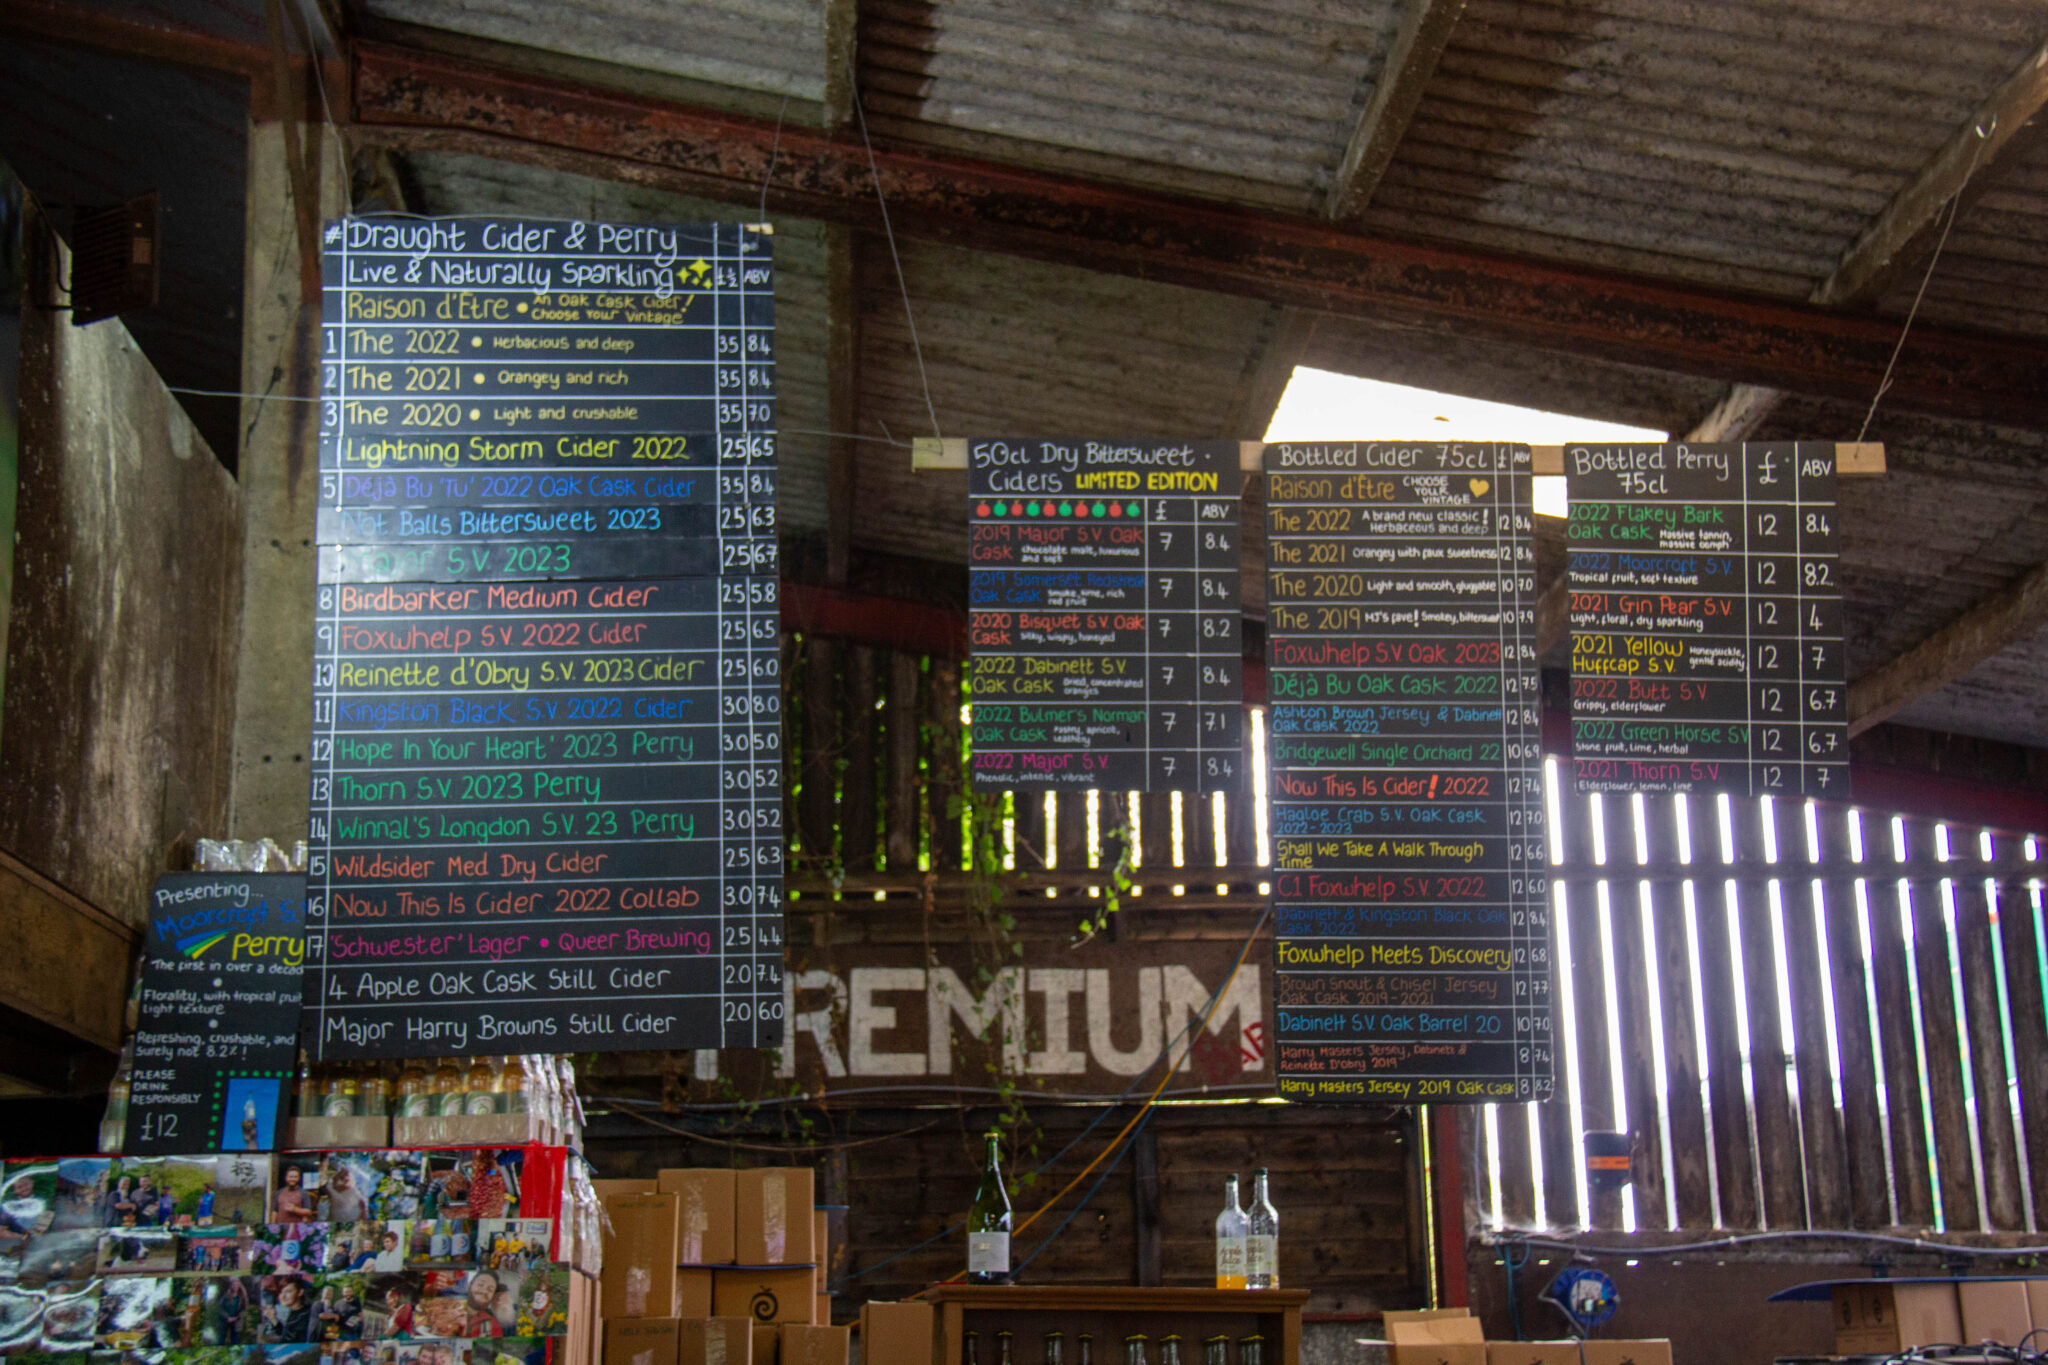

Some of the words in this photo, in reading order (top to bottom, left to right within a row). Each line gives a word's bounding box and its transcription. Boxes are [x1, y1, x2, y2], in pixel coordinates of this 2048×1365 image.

[349, 222, 465, 259] Draught
[482, 221, 559, 251] Cider
[564, 221, 584, 251] &
[599, 225, 677, 266] Perry
[349, 260, 397, 284] Live
[404, 261, 422, 283] &
[431, 259, 550, 295] Naturally
[562, 261, 674, 299] Sparkling
[326, 331, 336, 353] 1
[347, 329, 393, 354] The
[406, 330, 460, 354] 2022
[576, 337, 598, 349] and
[602, 337, 634, 352] deep
[324, 404, 338, 426] 3
[346, 402, 388, 425] The
[402, 404, 461, 426] 2020
[494, 406, 532, 424] Light
[539, 407, 565, 420] and
[572, 406, 638, 420] crushable
[346, 438, 459, 468] Lightning
[468, 438, 542, 460] Storm
[557, 437, 619, 459] Cider
[632, 437, 690, 460] 2022
[974, 442, 1030, 467] 50cl
[1040, 444, 1078, 472] Dry
[1086, 442, 1194, 465] Bittersweet
[1279, 445, 1357, 466] Bottled
[1366, 445, 1423, 466] Cider
[1436, 445, 1487, 468] 75cl
[1498, 449, 1506, 469] £
[1571, 445, 1666, 476] Bottled
[1676, 445, 1729, 481] Perry
[1758, 451, 1777, 483] £
[1802, 461, 1831, 477] ABV
[989, 470, 1062, 492] Ciders
[1076, 473, 1140, 489] LIMITED
[1148, 472, 1218, 491] EDITION
[1270, 475, 1332, 499] Raison
[1617, 473, 1668, 494] 75cl
[399, 512, 452, 536] Balls
[460, 509, 596, 536] Bittersweet
[608, 507, 661, 531] 2023
[1156, 501, 1167, 520] £
[1202, 505, 1229, 518] ABV
[1270, 509, 1300, 531] The
[1306, 509, 1351, 531] 2022
[1569, 505, 1609, 521] 2022
[1617, 505, 1676, 530] Flakey
[1684, 506, 1724, 523] Bark
[1758, 515, 1777, 535] 12
[1806, 514, 1830, 536] 8.4
[1367, 581, 1393, 594] Light
[1396, 581, 1413, 591] and
[1569, 572, 1608, 584] Tropical
[1664, 574, 1698, 585] texture
[342, 587, 479, 613] Birdbarker
[488, 588, 577, 609] Medium
[589, 585, 658, 607] Cider
[1571, 593, 1608, 613] 2021
[1620, 597, 1652, 613] Gin
[1661, 597, 1698, 614] Pear
[972, 614, 1012, 628] 2020
[1019, 615, 1081, 632] Bisquet
[1159, 620, 1171, 637] 7
[1204, 619, 1230, 637] 8.2
[1637, 615, 1653, 629] dry
[1657, 616, 1703, 632] sparkling
[342, 625, 471, 653] Foxwhelp
[521, 624, 579, 646] 2022
[589, 623, 647, 644] Cider
[1274, 640, 1370, 667] Foxwhelp
[1408, 644, 1448, 664] Oak
[1455, 644, 1500, 662] 2023
[1572, 636, 1613, 654] 2021
[1624, 637, 1683, 657] Yellow
[1758, 646, 1778, 669] 12
[1812, 647, 1825, 669] 7
[340, 660, 440, 687] Reinette
[450, 658, 529, 691] d'Obry
[583, 659, 634, 683] 2023
[636, 656, 704, 681] Cider
[975, 657, 1015, 674] 2022
[1023, 657, 1094, 675] Dabinett
[1162, 667, 1174, 685] 7
[1204, 667, 1230, 685] 8.4
[1273, 673, 1319, 698] Déjà
[1326, 675, 1350, 694] Bu
[1357, 674, 1394, 693] Oak
[1401, 675, 1447, 694] Cask
[1455, 676, 1498, 693] 2022
[1574, 680, 1617, 698] 2022
[1629, 680, 1671, 700] Butt
[1762, 689, 1783, 711] 12
[1810, 690, 1837, 711] 6.7
[975, 754, 1013, 769] 2022
[1022, 754, 1073, 774] Major
[1274, 740, 1356, 766] Bridgewell
[1361, 742, 1409, 767] Single
[1414, 743, 1472, 761] Orchard
[1480, 744, 1499, 760] 22
[1275, 775, 1317, 796] Now
[1323, 775, 1356, 796] This
[1363, 776, 1377, 795] Is
[1444, 777, 1489, 795] 2022
[440, 815, 530, 845] Longdon
[586, 811, 617, 836] 23
[631, 809, 694, 840] Perry
[334, 854, 435, 878] Wildsider
[448, 852, 488, 876] Med
[502, 852, 536, 883] Dry
[546, 852, 608, 873] Cider
[232, 932, 304, 966] Perry
[469, 934, 529, 961] Lager
[559, 932, 614, 951] Queer
[625, 928, 710, 960] Brewing
[1277, 942, 1363, 968] Foxwhelp
[1372, 945, 1423, 964] Meets
[1429, 945, 1511, 970] Discovery
[143, 1003, 174, 1018] Light
[179, 1004, 224, 1015] texture
[695, 963, 1265, 1080] REMIUM
[1279, 1012, 1347, 1032] Dabinett
[1381, 1015, 1414, 1030] Oak
[1420, 1014, 1467, 1030] Barrel
[1476, 1016, 1499, 1033] 20
[327, 1017, 394, 1046] Major
[406, 1016, 466, 1048] Harry
[477, 1014, 557, 1038] Browns
[570, 1014, 614, 1035] Still
[622, 1012, 677, 1035] Cider
[133, 1082, 169, 1091] DRINK
[134, 1070, 176, 1080] PLEASE
[131, 1094, 201, 1104] RESPONSIBLY
[141, 1112, 178, 1141] £12
